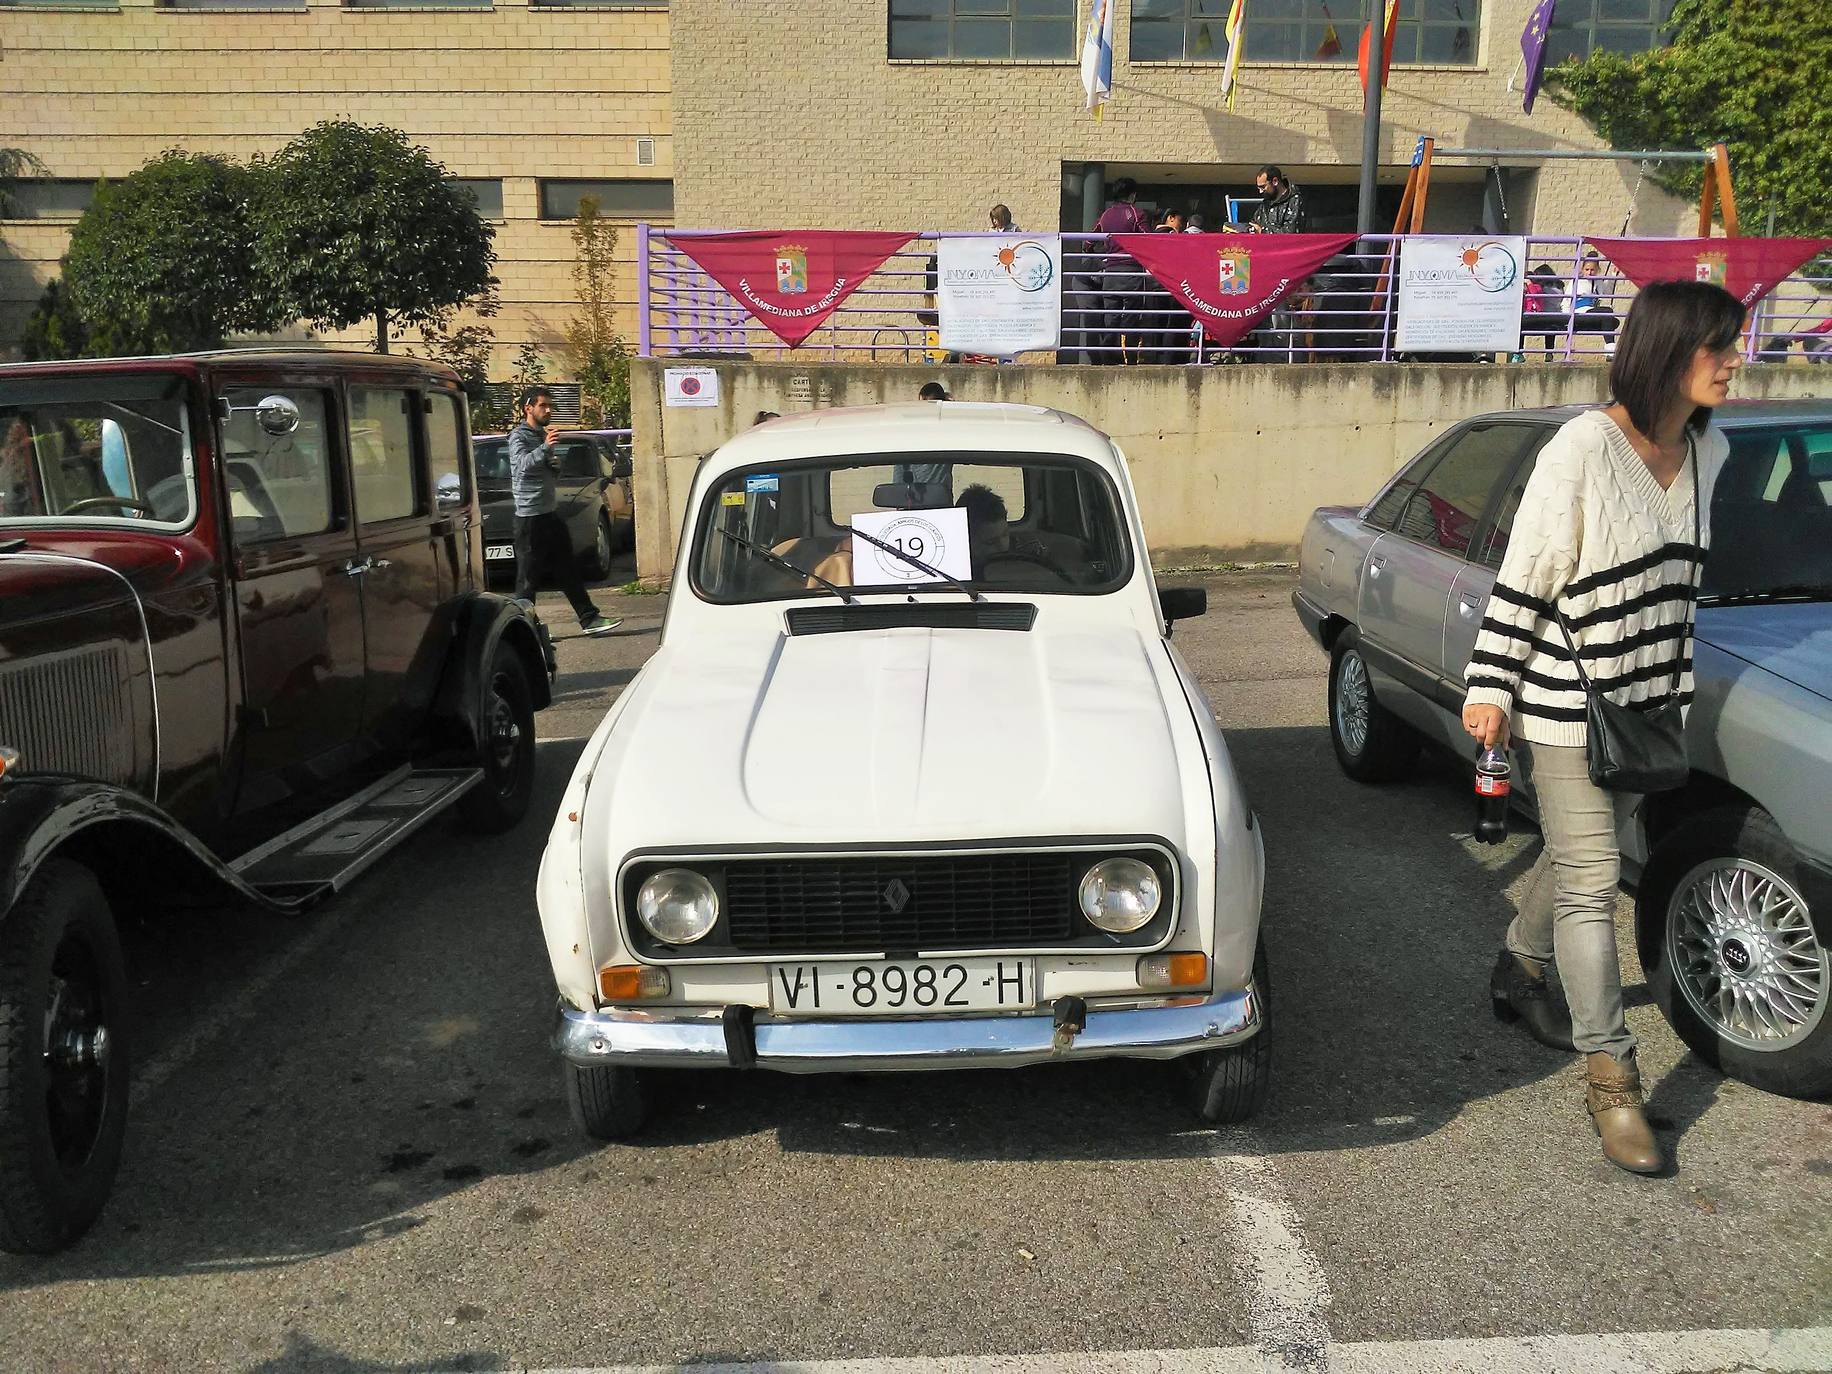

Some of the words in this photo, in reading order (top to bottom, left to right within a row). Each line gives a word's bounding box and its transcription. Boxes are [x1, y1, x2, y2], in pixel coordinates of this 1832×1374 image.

[738, 277, 803, 317] VILLAMEDIANA
[804, 304, 819, 316] DE
[818, 277, 847, 309] IREGUA
[1179, 279, 1243, 319] VILLAMEDIANA
[1244, 306, 1259, 317] DE
[1259, 277, 1291, 311] IREGUA
[894, 536, 924, 559] 19
